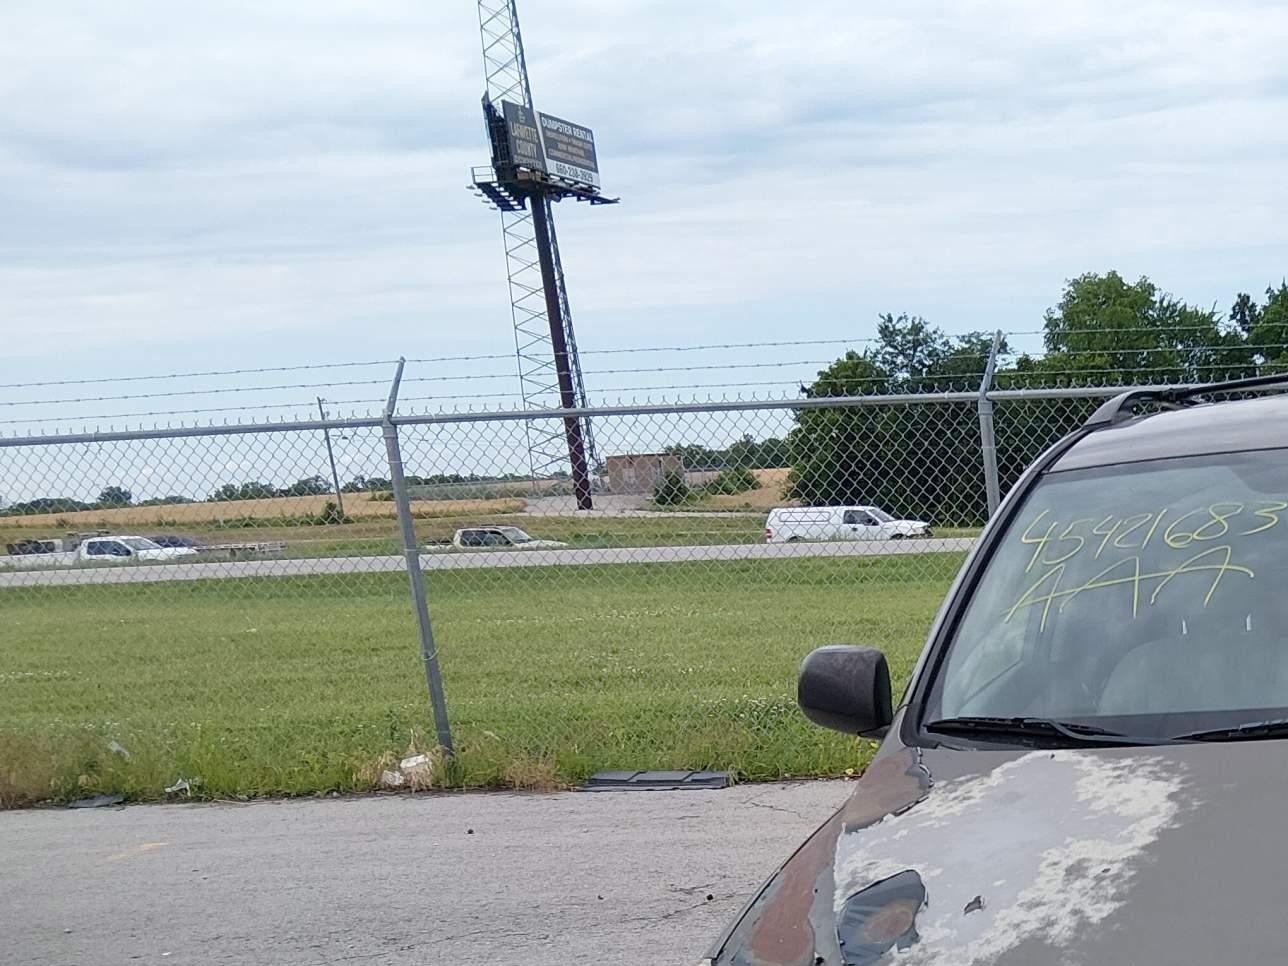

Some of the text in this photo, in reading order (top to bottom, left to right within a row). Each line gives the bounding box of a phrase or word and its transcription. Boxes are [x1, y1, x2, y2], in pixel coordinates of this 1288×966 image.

[511, 121, 539, 143] LAFAYETTE
[541, 116, 573, 136] DUMPSTER
[573, 127, 592, 141] RENTAL
[515, 139, 537, 158] COUNTY
[1021, 500, 1288, 572] 45421683
